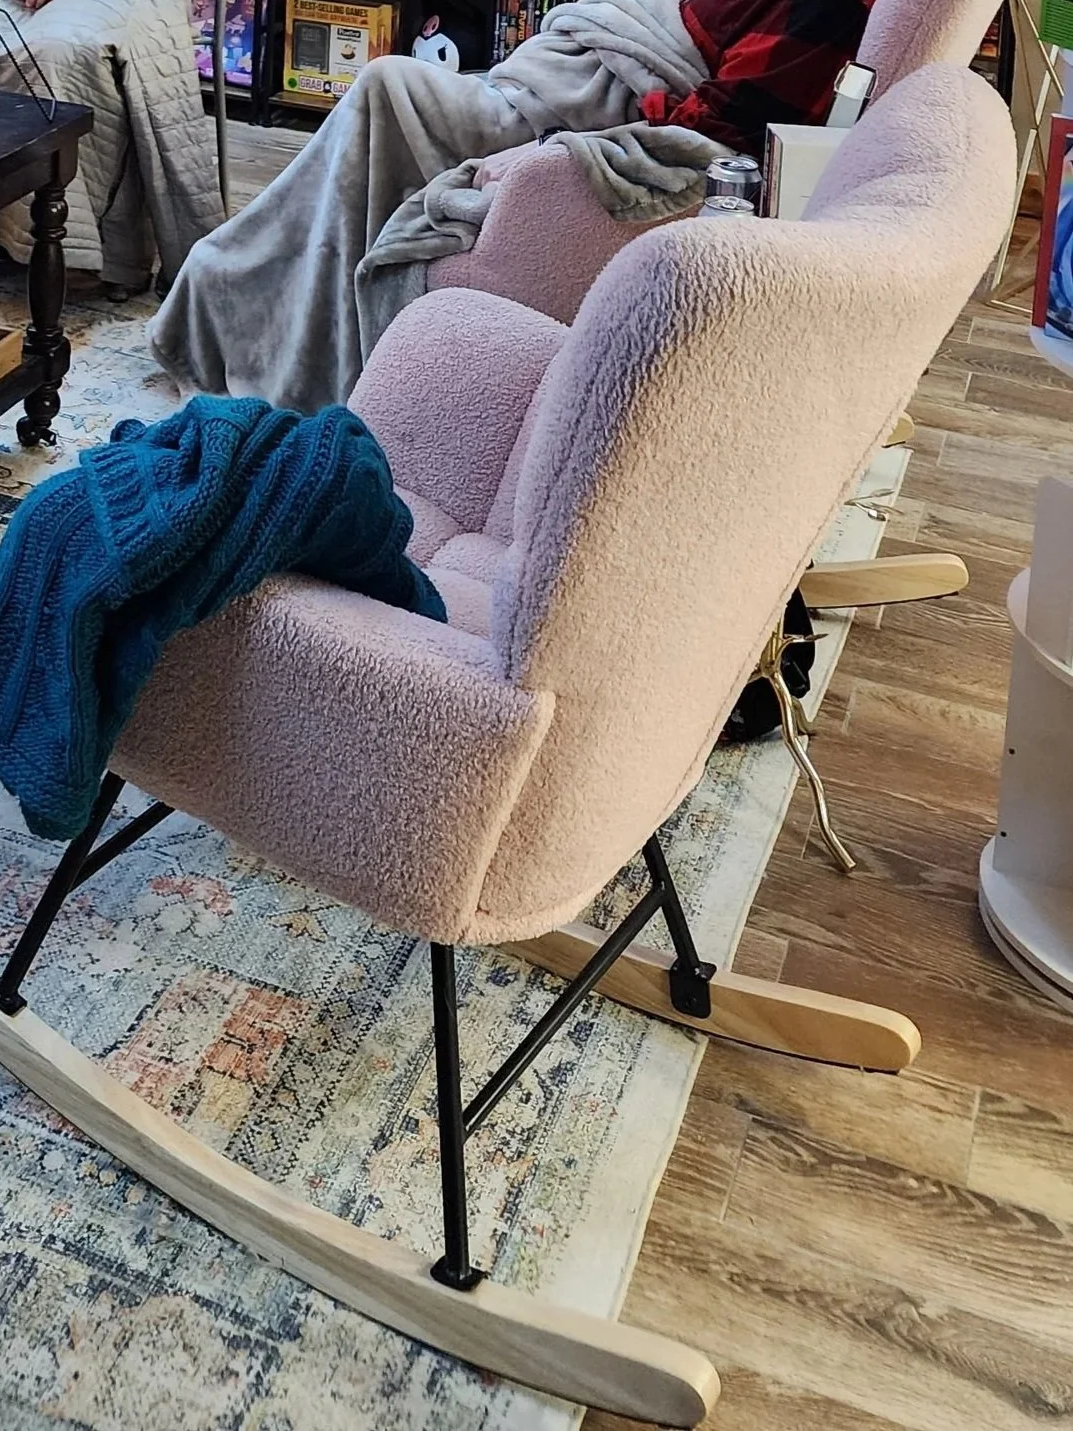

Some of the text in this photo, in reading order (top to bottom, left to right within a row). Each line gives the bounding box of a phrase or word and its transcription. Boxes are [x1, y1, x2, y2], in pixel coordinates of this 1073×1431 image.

[293, 0, 299, 8] 2
[300, 0, 345, 15] BEST-SELLING
[345, 6, 368, 17] GAMES
[300, 77, 323, 91] GRAB
[333, 82, 351, 94] GAM
